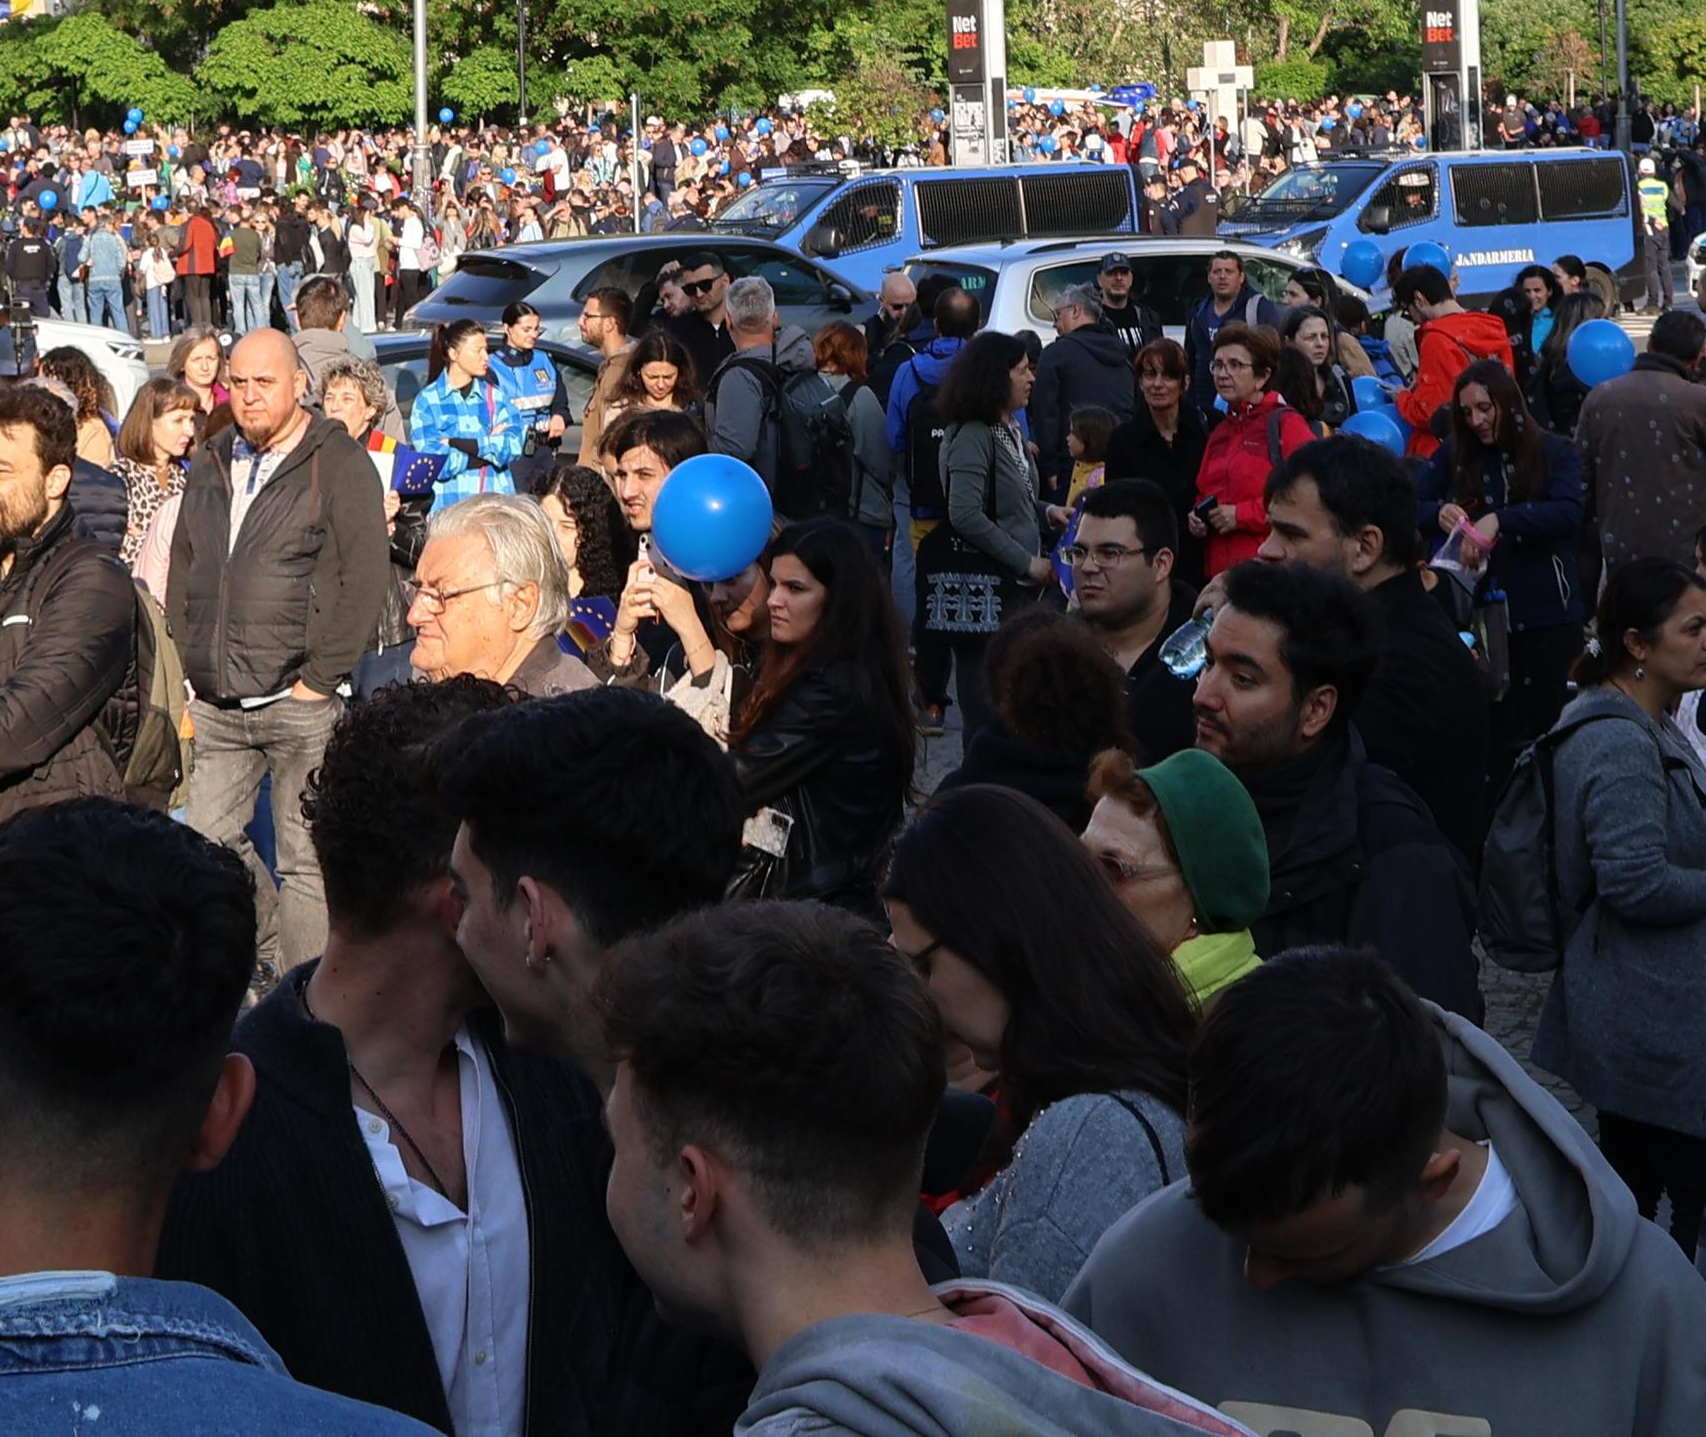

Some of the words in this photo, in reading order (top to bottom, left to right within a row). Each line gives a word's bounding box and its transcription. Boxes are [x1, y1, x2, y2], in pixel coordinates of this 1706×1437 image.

[952, 15, 977, 33] Net
[1426, 11, 1453, 28] Net
[953, 33, 978, 50] Bet
[1426, 27, 1453, 43] Bet
